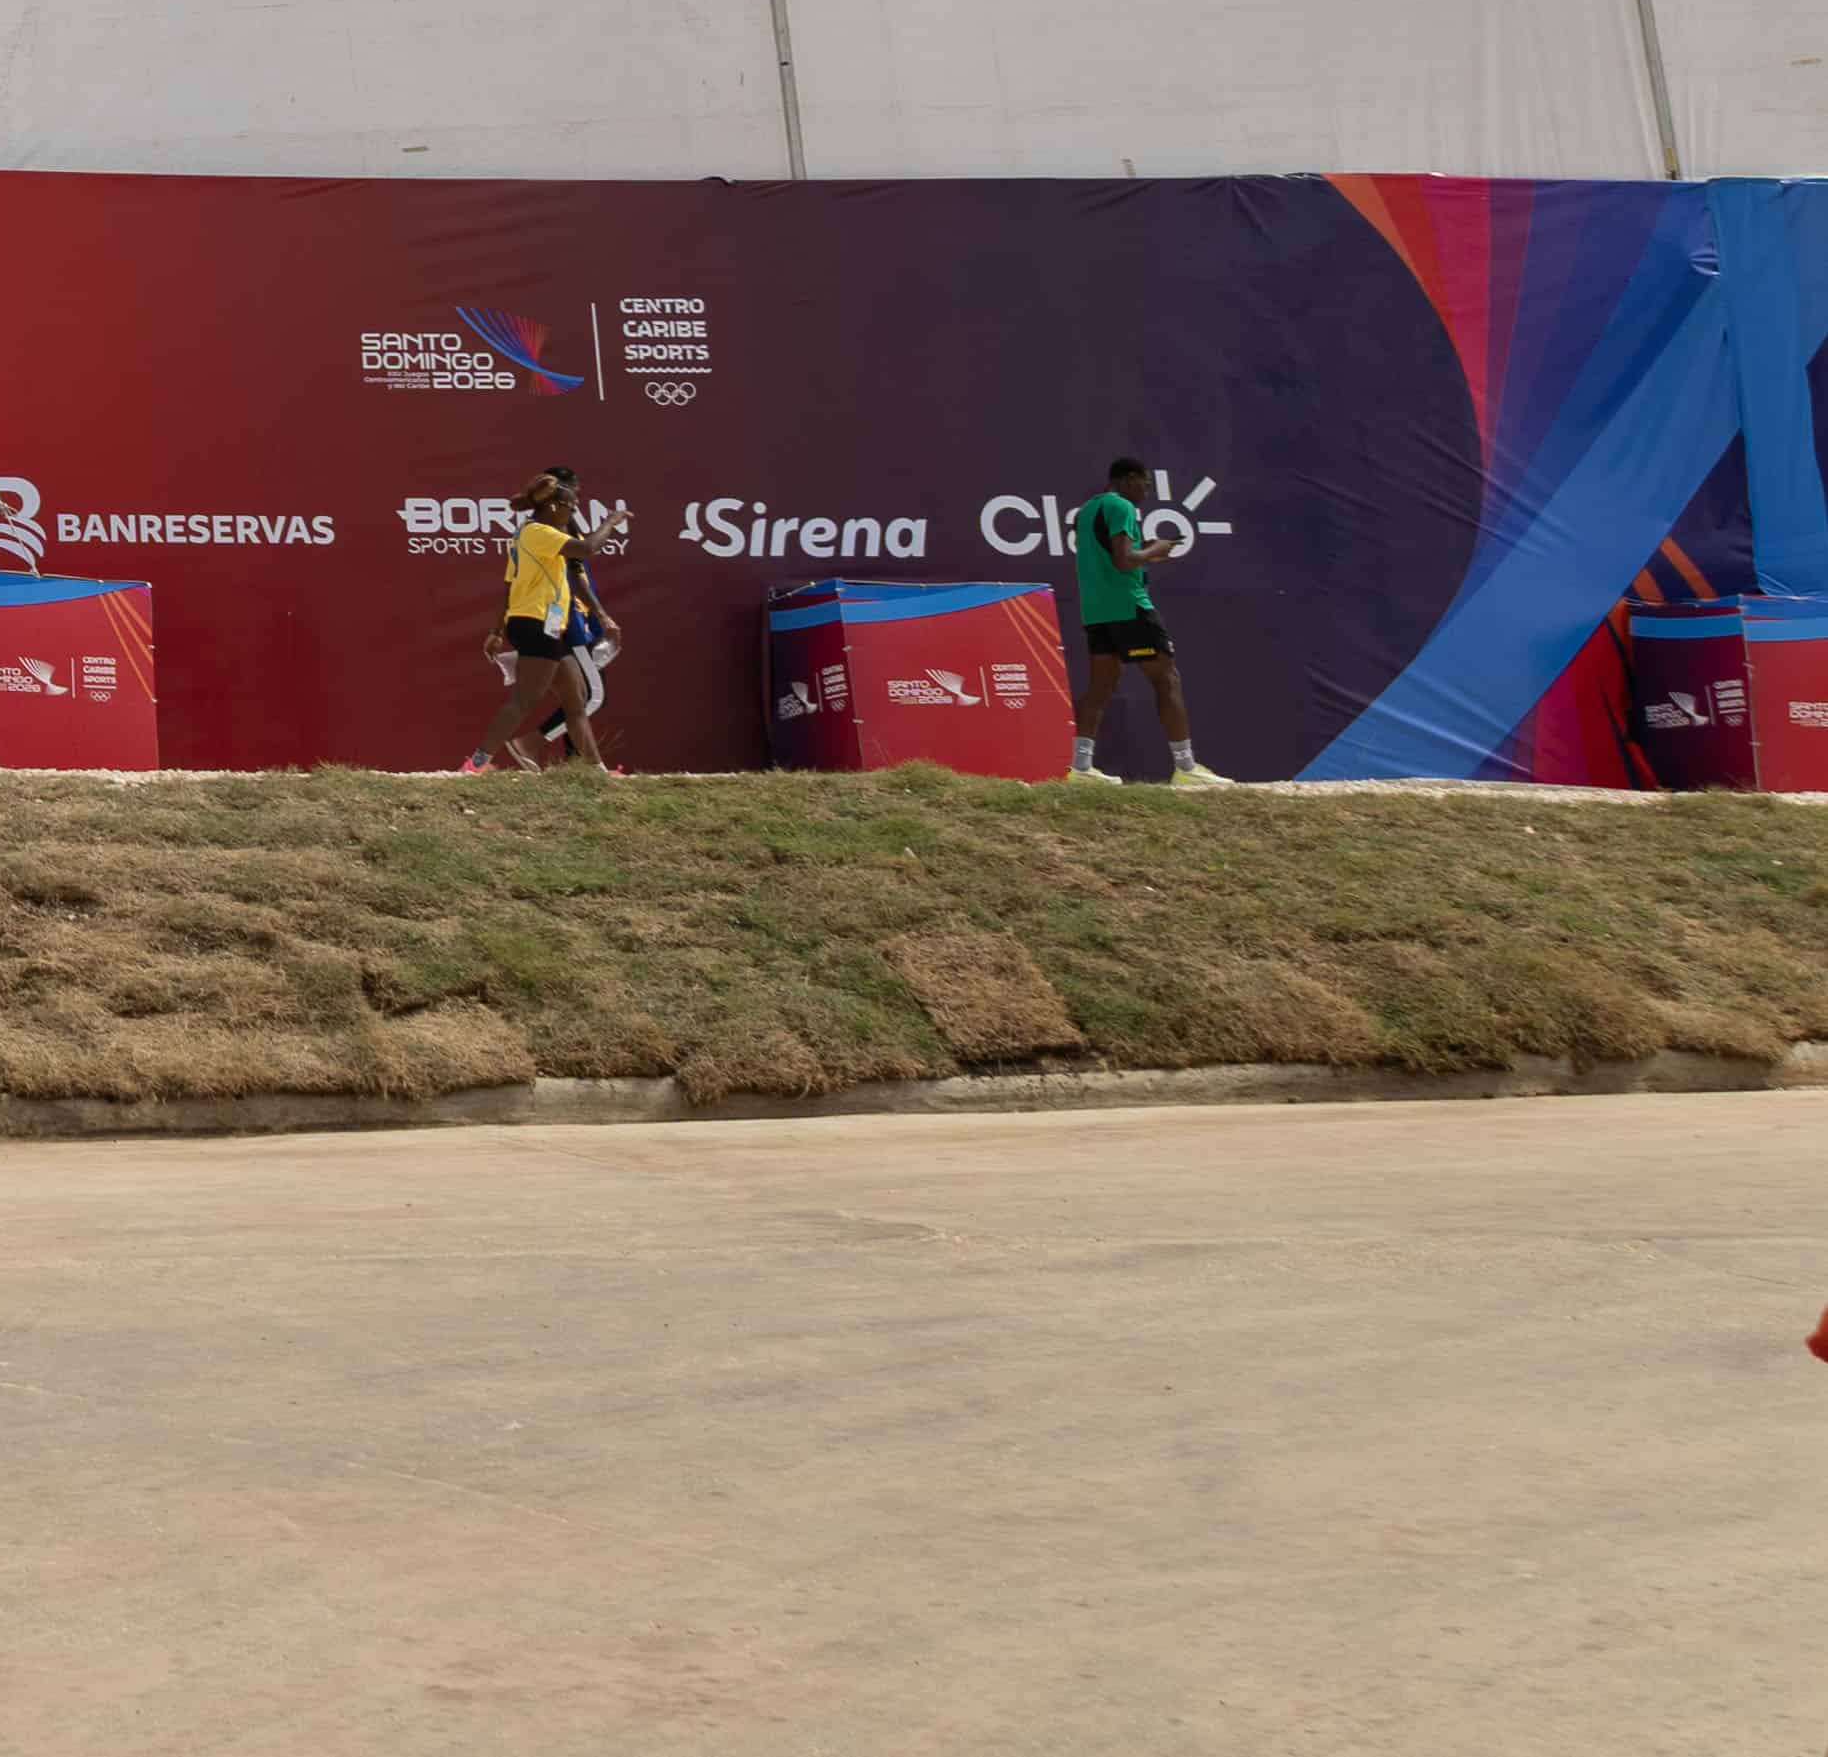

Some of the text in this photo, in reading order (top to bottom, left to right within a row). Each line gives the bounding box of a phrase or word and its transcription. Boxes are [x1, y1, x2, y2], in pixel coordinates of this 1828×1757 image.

[620, 298, 705, 314] CENTRO
[623, 320, 708, 338] CARIBE
[360, 333, 462, 351] SANTO
[361, 352, 494, 371] DOMINGO
[624, 344, 710, 361] SPORTS
[432, 372, 516, 390] 2026
[397, 497, 629, 535] BORN
[56, 513, 336, 545] BANRESERVAS
[701, 497, 928, 558] Sirena
[980, 495, 1195, 558] Clo
[407, 538, 486, 555] SPORTS
